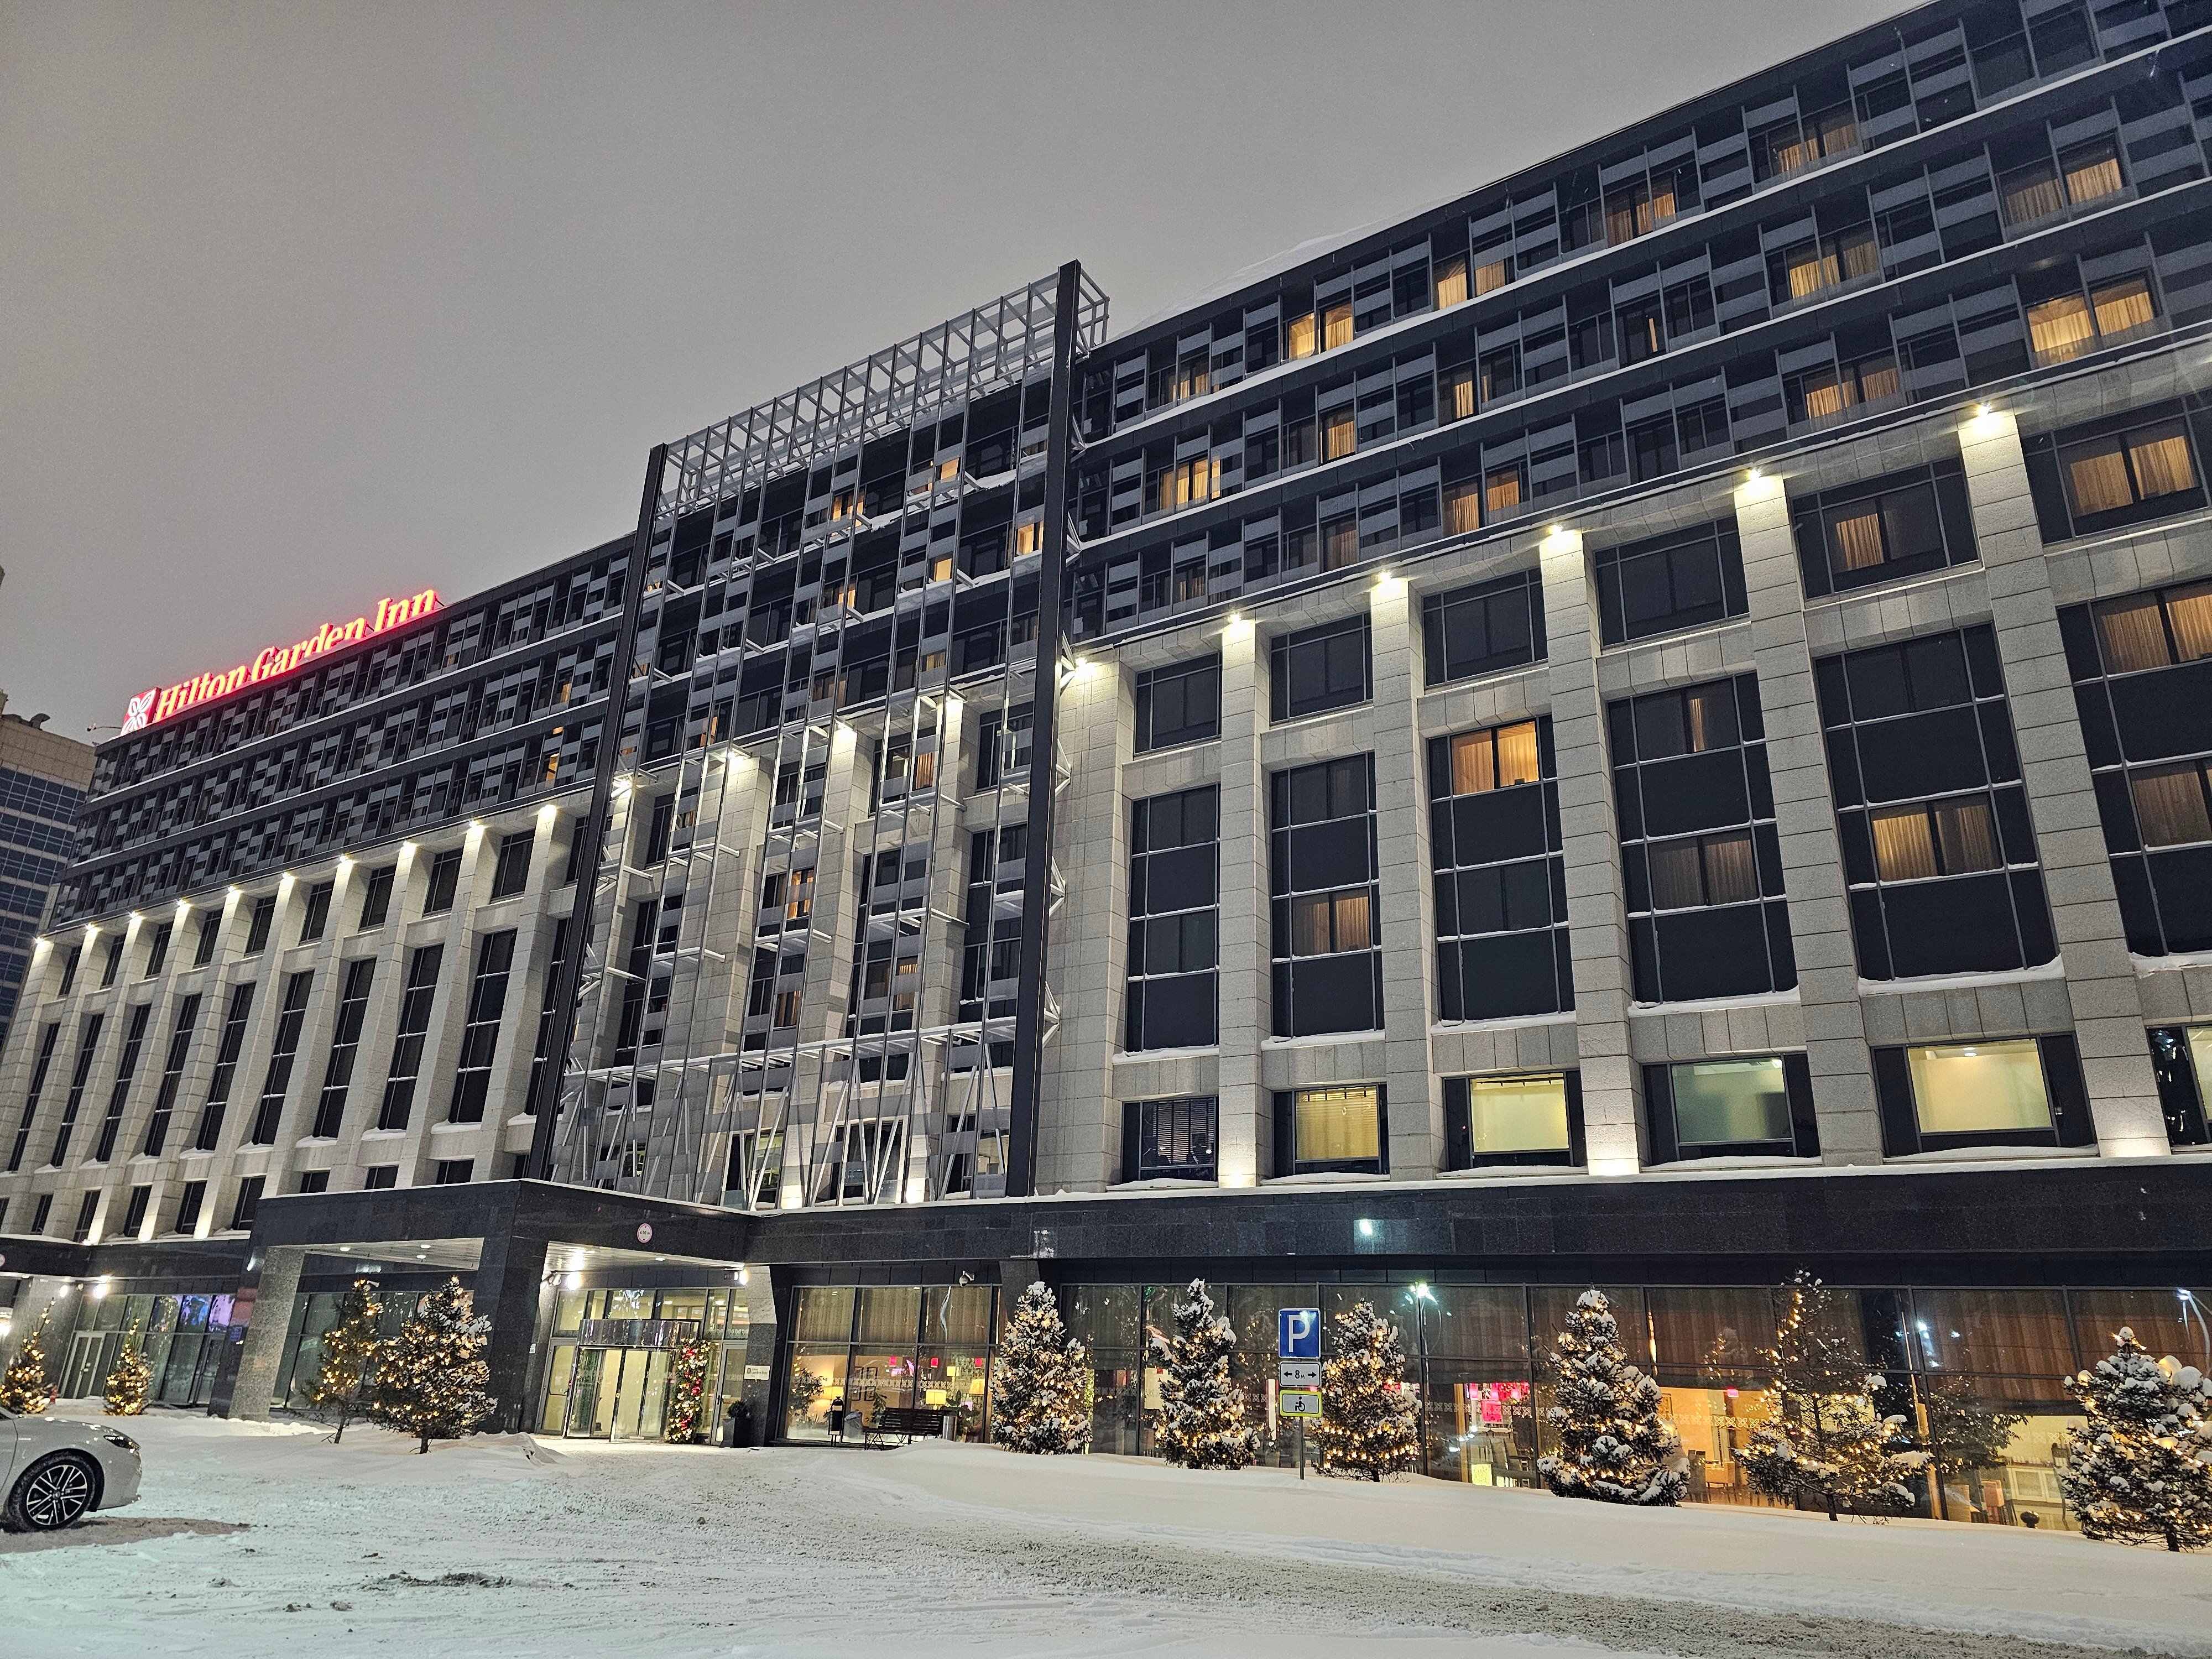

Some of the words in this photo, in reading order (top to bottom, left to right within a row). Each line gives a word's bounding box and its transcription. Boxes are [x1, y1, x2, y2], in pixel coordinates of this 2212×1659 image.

[155, 665, 248, 721] Hilton
[251, 617, 367, 682] Garden
[374, 589, 436, 633] Inn
[1288, 1314, 1310, 1353] P
